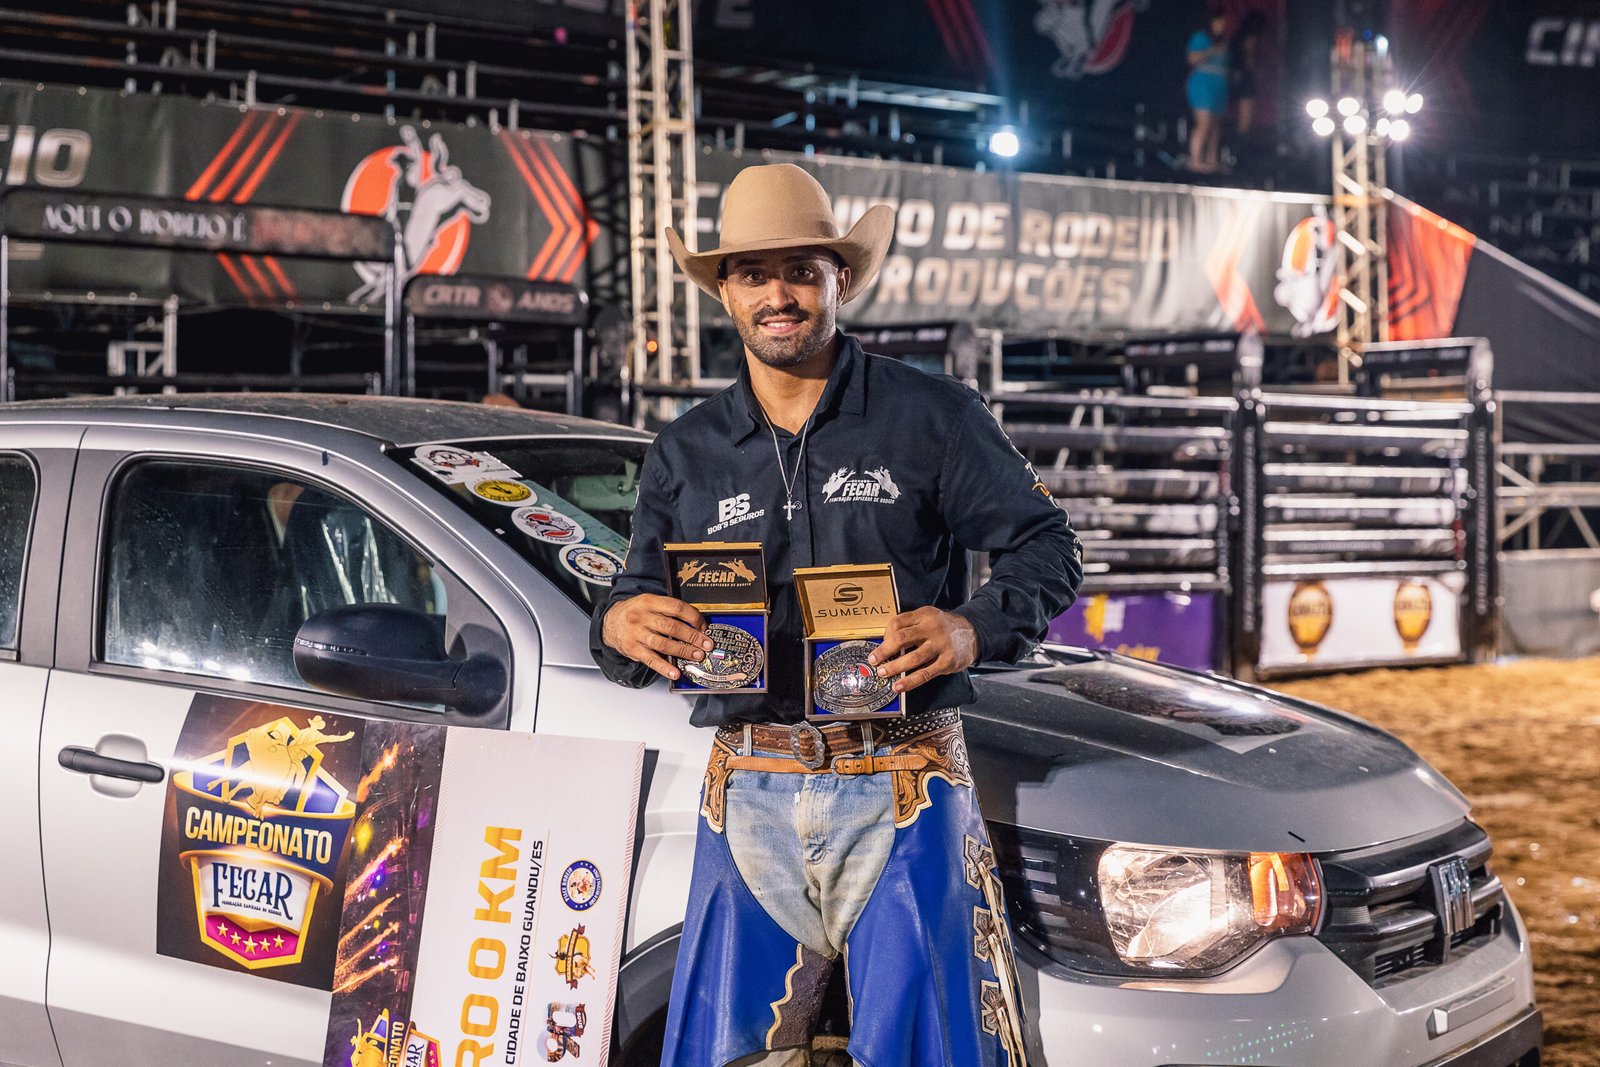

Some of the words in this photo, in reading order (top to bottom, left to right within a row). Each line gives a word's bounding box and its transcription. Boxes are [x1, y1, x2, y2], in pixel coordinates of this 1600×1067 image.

[43, 203, 101, 235] AQUI
[108, 206, 132, 233] O
[943, 201, 1010, 251] DE
[1018, 207, 1179, 262] RODEIO
[718, 493, 751, 523] BS
[842, 482, 881, 498] FECAR
[707, 521, 729, 535] BOB'S
[697, 571, 736, 583] FECAR
[814, 605, 890, 618] SUMETAL
[184, 806, 333, 865] CAMPEONATO
[211, 861, 294, 921] FECAR
[473, 825, 523, 924] KM
[522, 840, 543, 932] GUANDU/ES
[515, 934, 531, 982] BAIXO
[512, 984, 525, 1006] DE
[454, 993, 499, 1067] RO
[505, 1008, 522, 1065] CIDADE
[576, 1011, 584, 1029] anos
